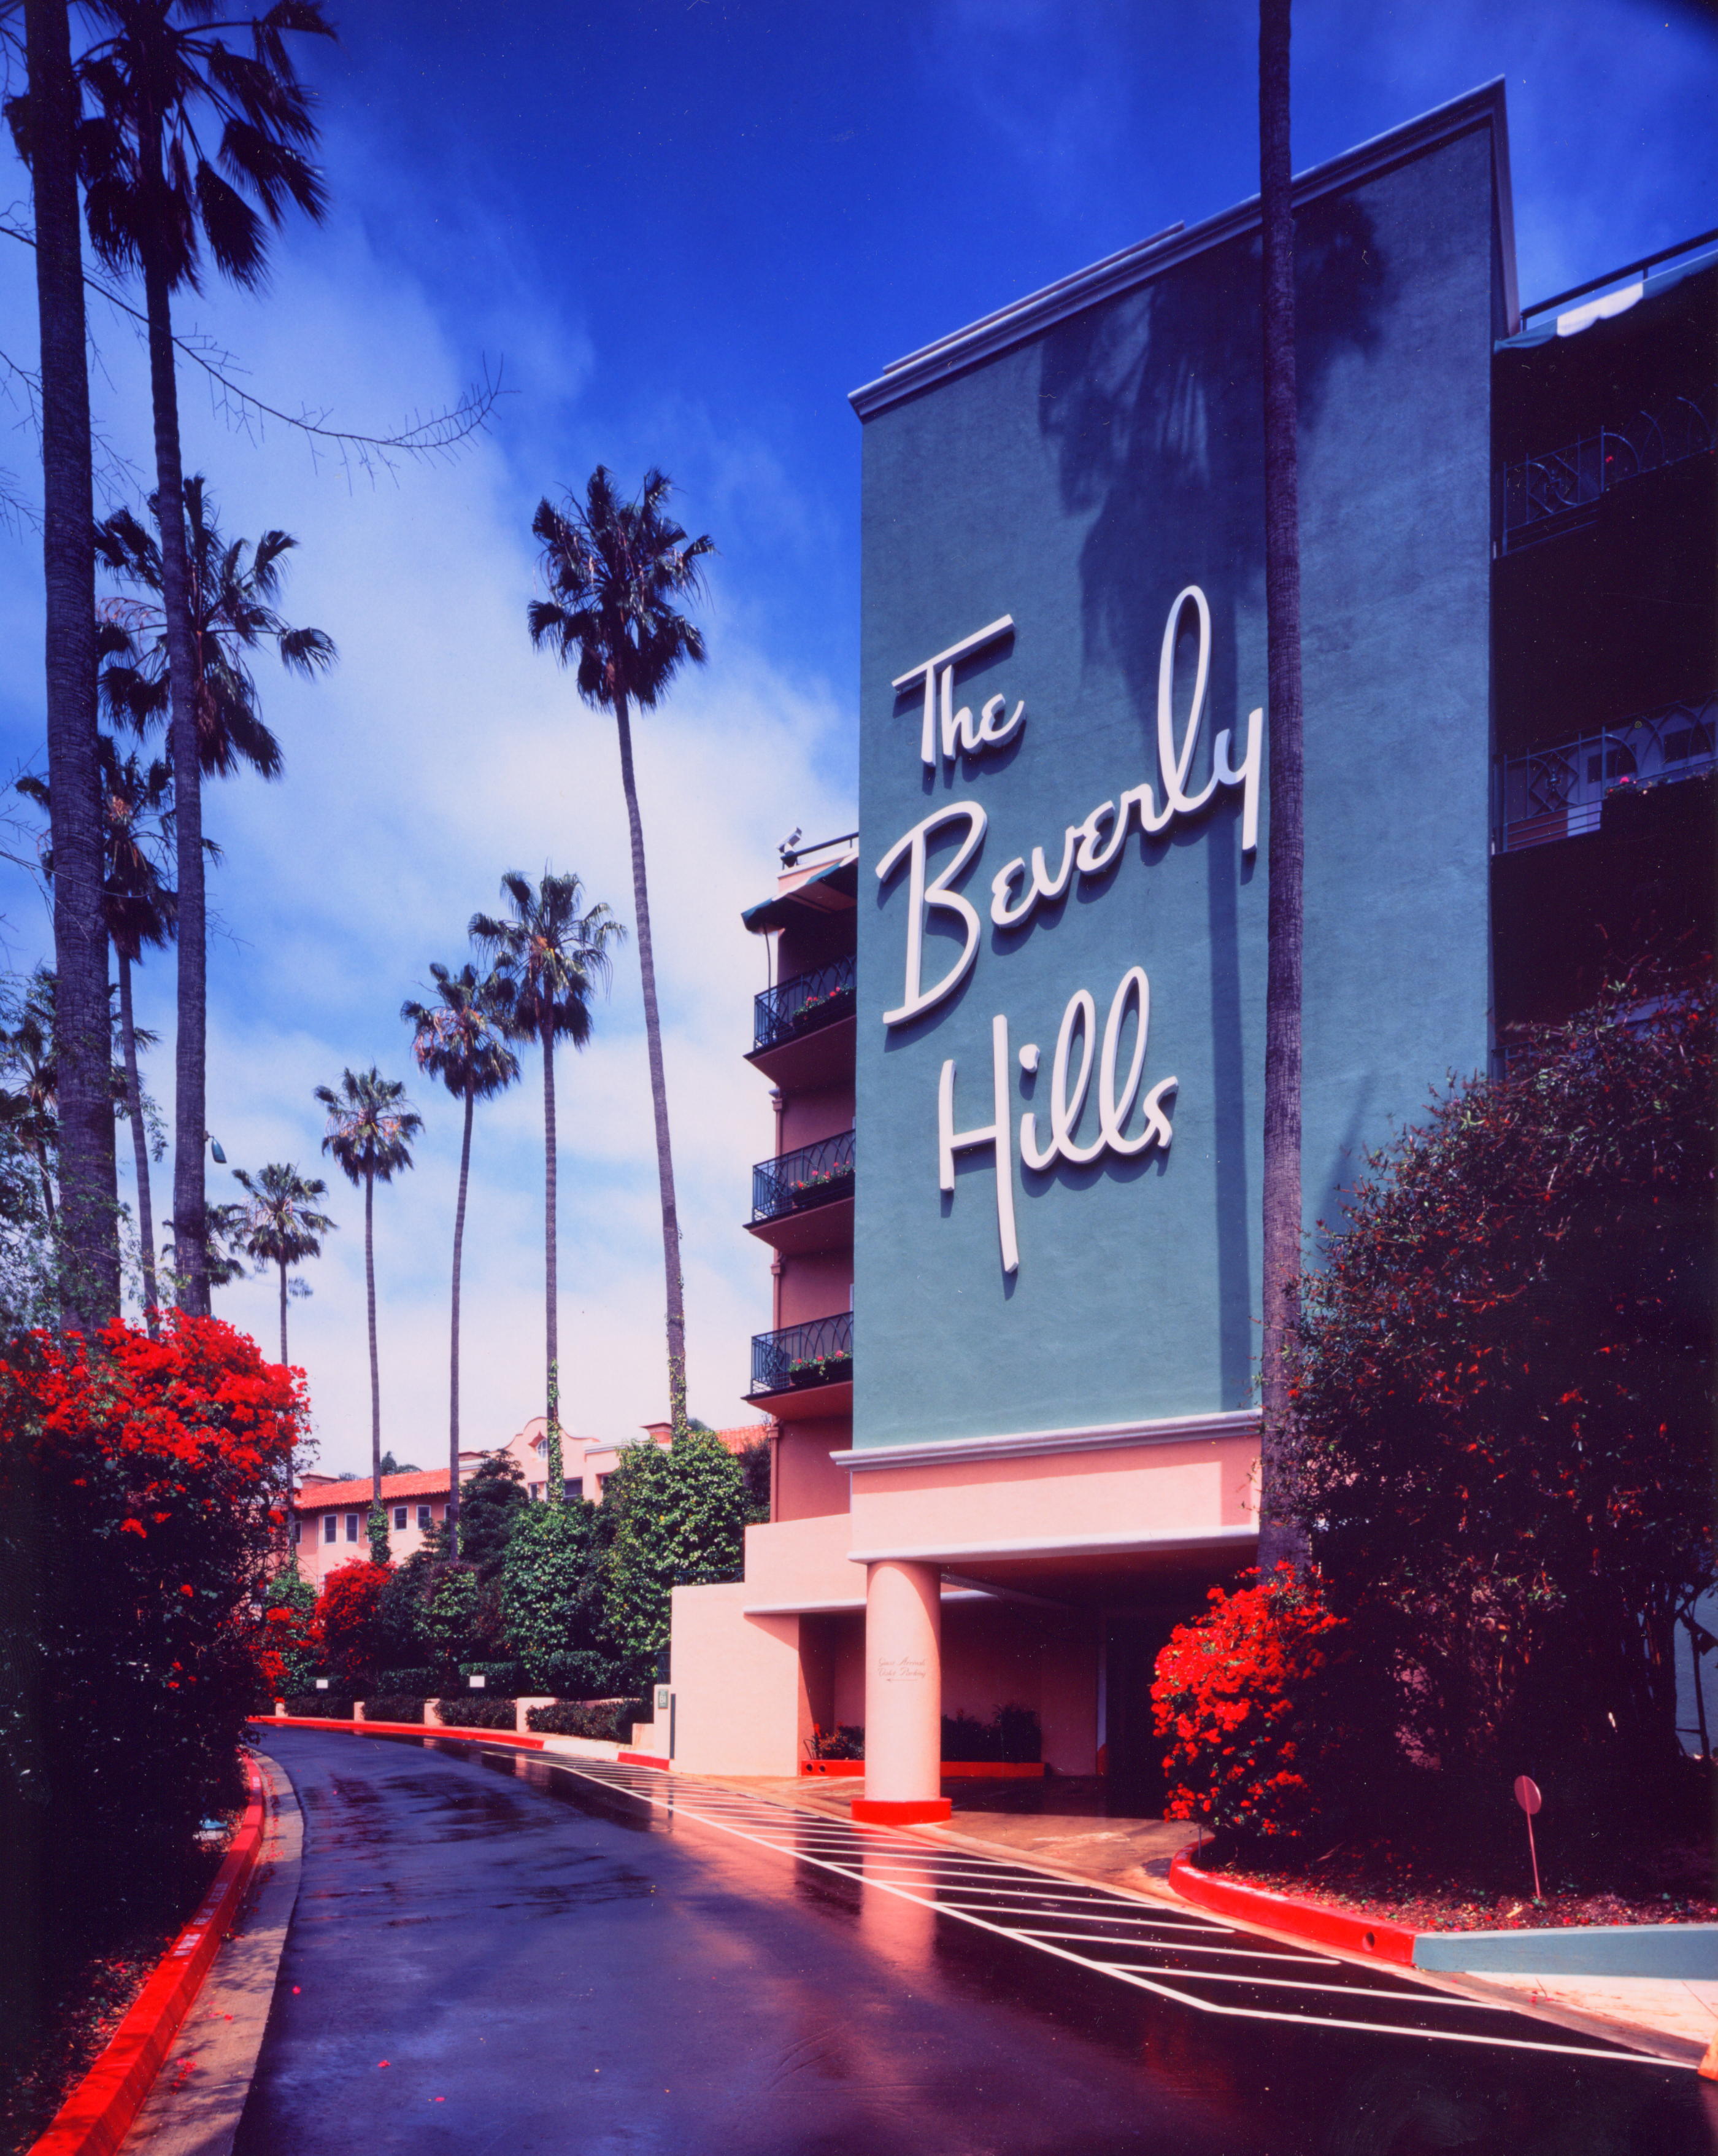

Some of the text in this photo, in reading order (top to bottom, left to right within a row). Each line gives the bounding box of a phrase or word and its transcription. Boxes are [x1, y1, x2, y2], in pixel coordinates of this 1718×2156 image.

[875, 585, 1264, 1026] Beverly
[891, 613, 1026, 767] The
[938, 965, 1179, 1274] Hills
